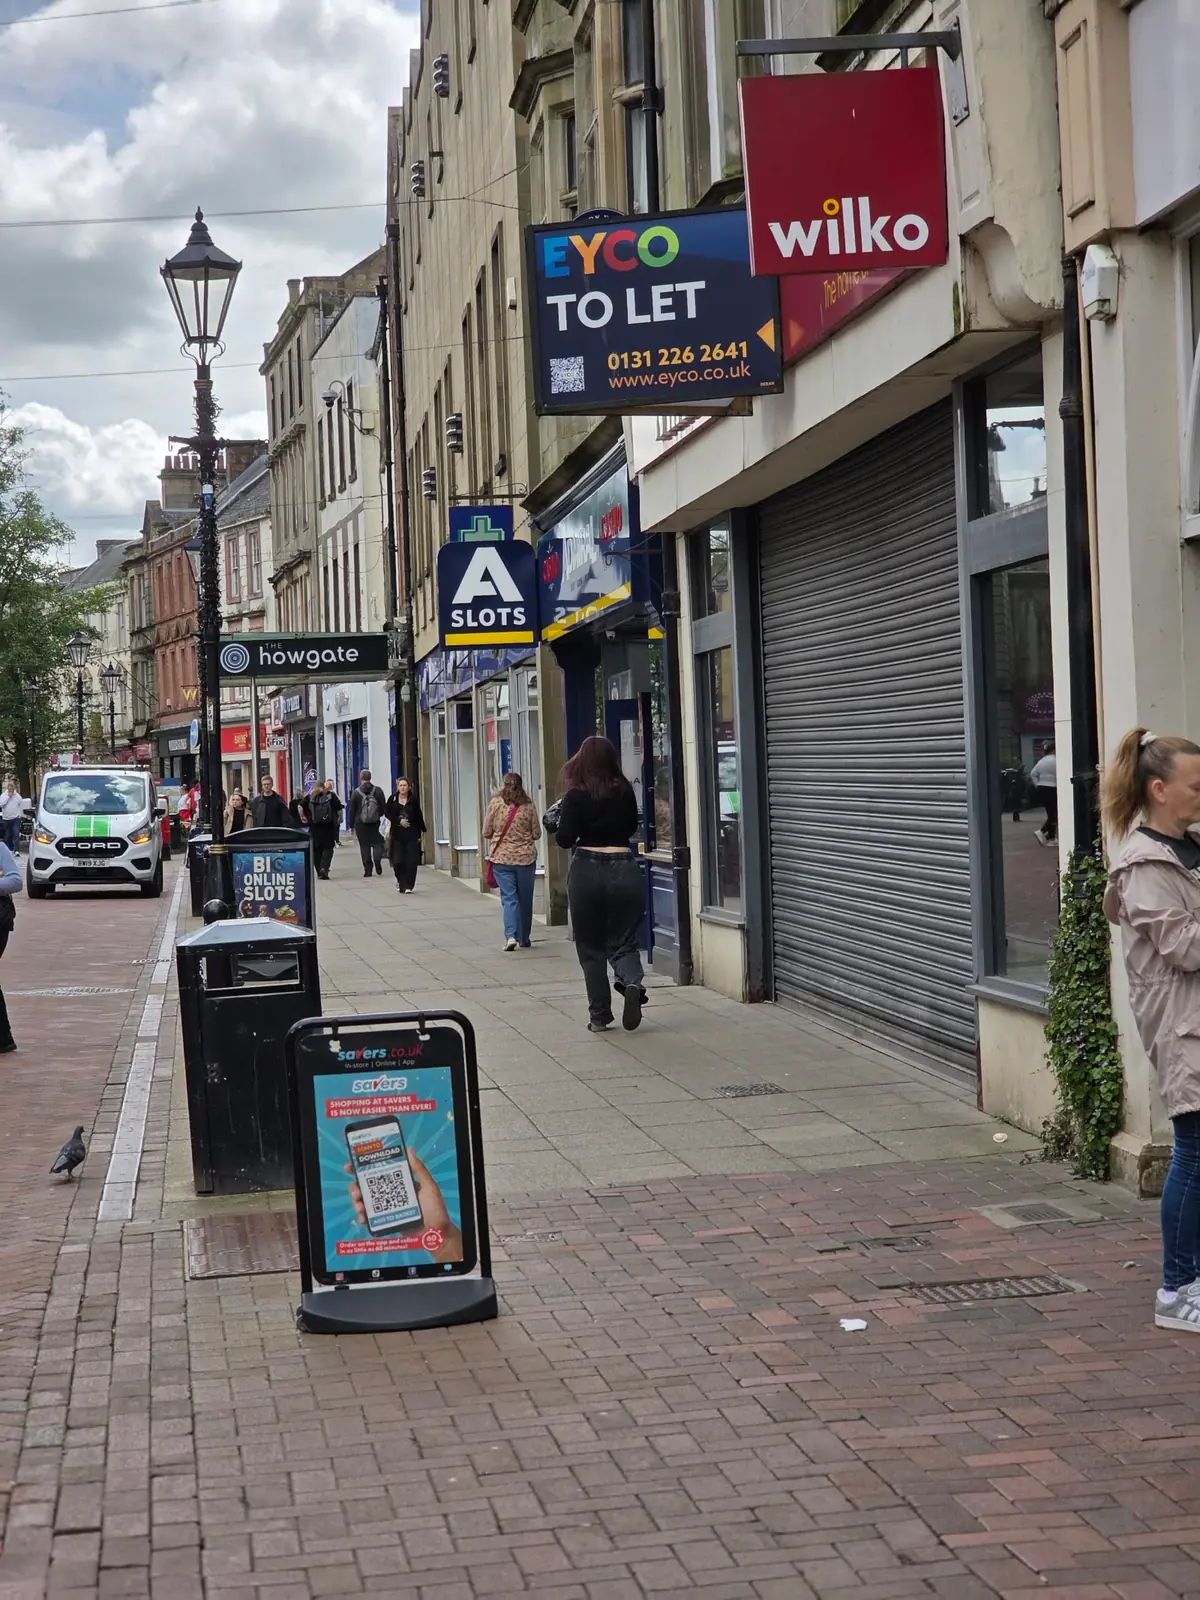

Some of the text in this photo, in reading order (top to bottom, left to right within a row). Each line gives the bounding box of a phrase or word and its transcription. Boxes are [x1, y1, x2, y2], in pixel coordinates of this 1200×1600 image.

[768, 196, 929, 258] wilko
[543, 225, 680, 278] EYCO
[546, 280, 706, 331] TO LET
[607, 340, 748, 370] 0131 226 2641
[608, 360, 751, 389] www.eyco.co.uk
[452, 546, 525, 604] A
[451, 607, 526, 628] SLOTS
[259, 646, 359, 670] howgate
[243, 872, 295, 886] ONLINE
[243, 886, 296, 901] SLOTS
[344, 1059, 415, 1069] In-store Online App
[352, 1075, 407, 1092] savers
[330, 1095, 412, 1108] SHOPPING AT SAVERS
[330, 1102, 432, 1117] IS NOW EASIER THAN EVER!
[358, 1147, 401, 1162] DOWNLOAD
[339, 1240, 357, 1248] Order
[354, 1246, 367, 1254] little
